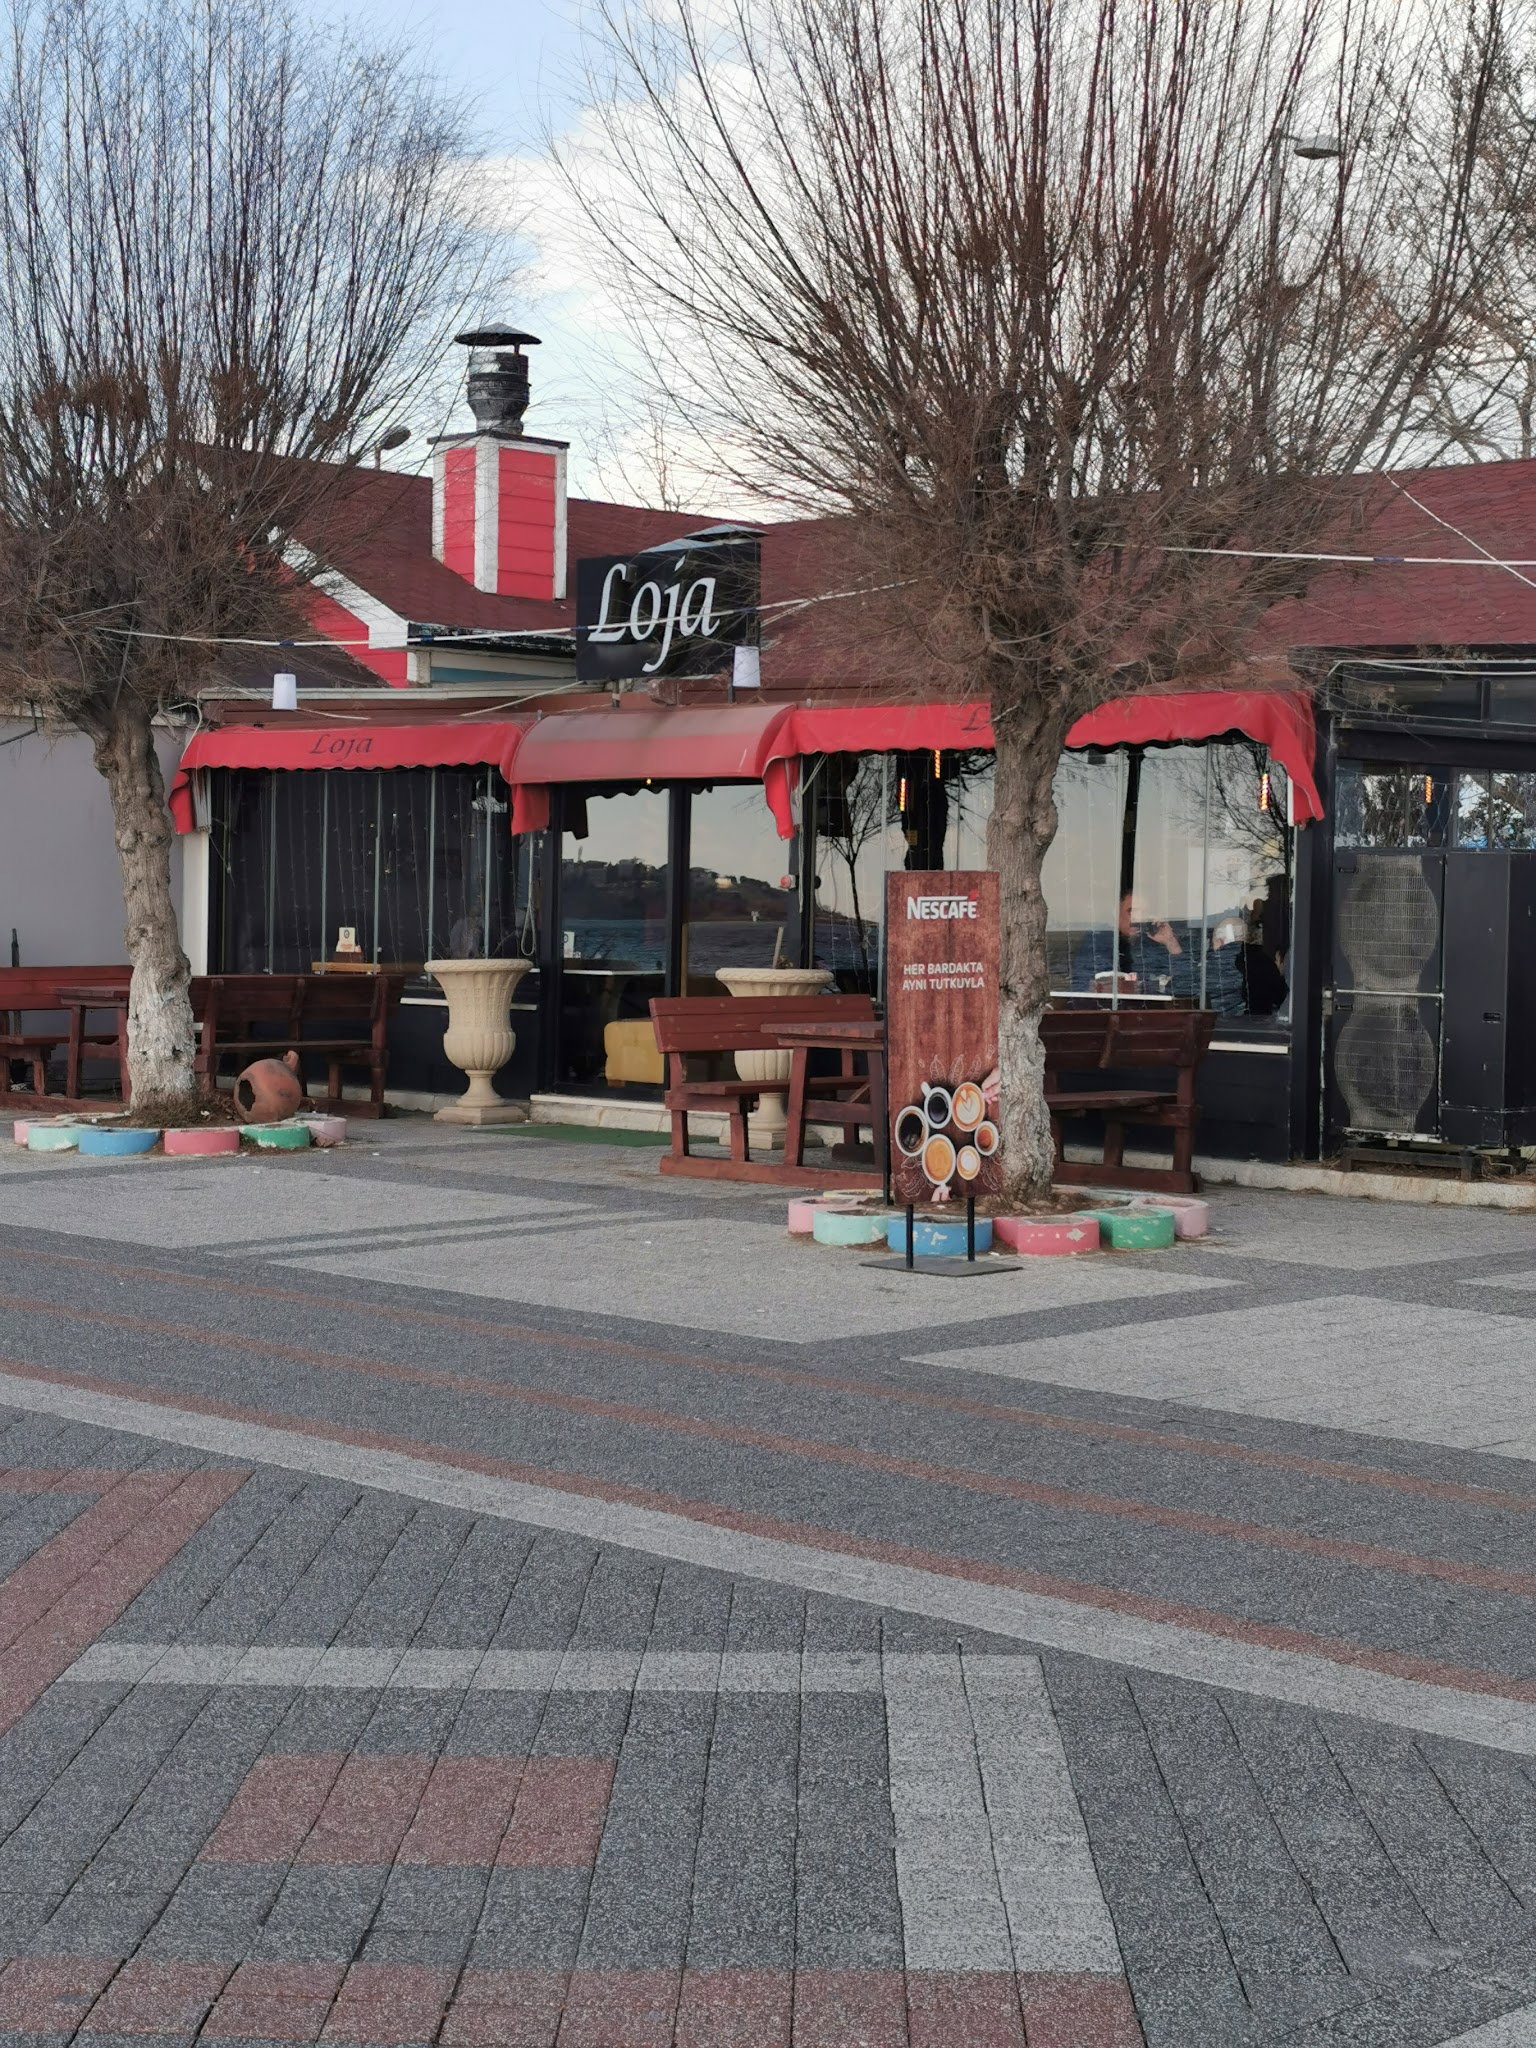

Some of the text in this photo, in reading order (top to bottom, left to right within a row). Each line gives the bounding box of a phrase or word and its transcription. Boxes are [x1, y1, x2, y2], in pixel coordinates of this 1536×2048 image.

[587, 555, 720, 673] Loja
[309, 733, 374, 762] Loja
[903, 961, 984, 976] HER BARDAKTA
[902, 976, 985, 991] AYNI TUTKUYLA
